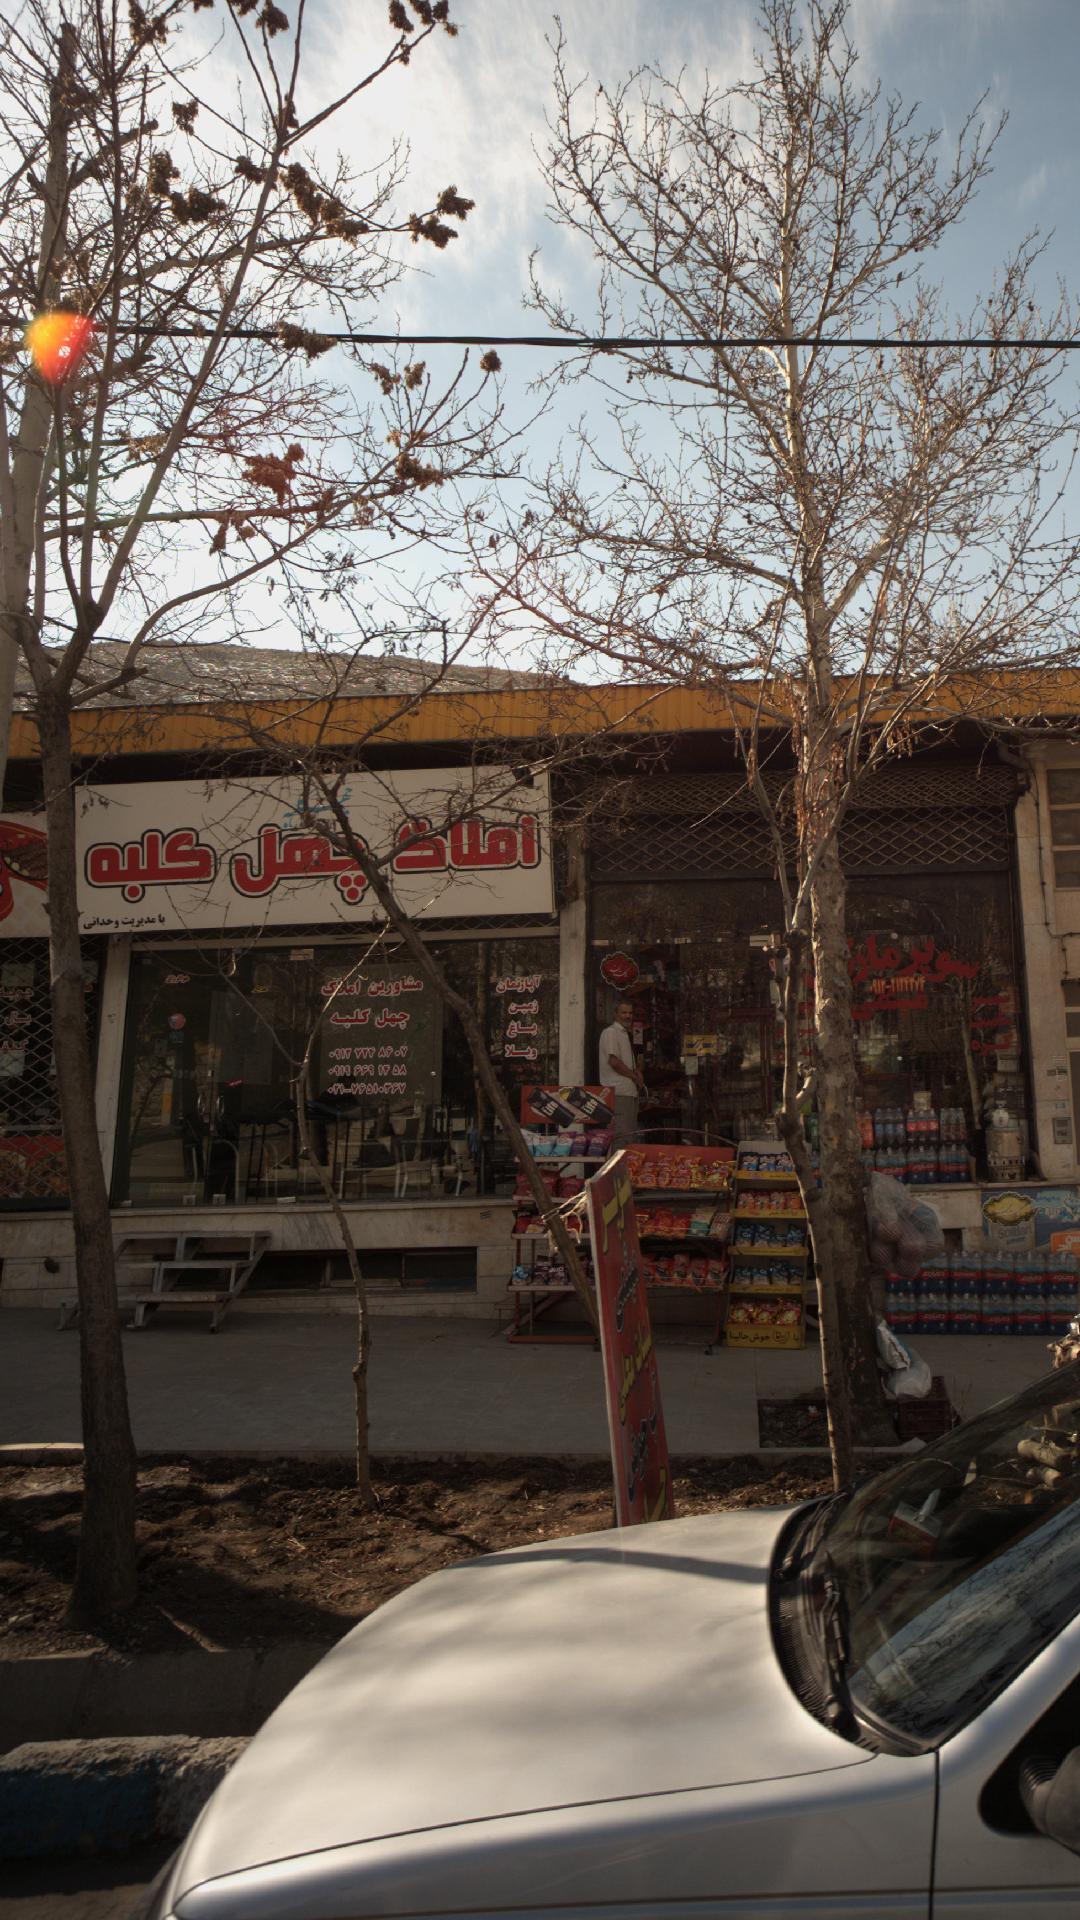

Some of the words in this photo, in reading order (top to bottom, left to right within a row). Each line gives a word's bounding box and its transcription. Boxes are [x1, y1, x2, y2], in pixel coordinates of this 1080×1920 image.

[390, 812, 541, 874] املاک
[84, 827, 216, 903] کلبه
[228, 823, 378, 906] چهل
[121, 915, 156, 928] مدیریت
[158, 913, 166, 926] با
[320, 978, 361, 996] املاک
[368, 976, 424, 997] مشاورین
[496, 974, 541, 993] آپارتمان
[508, 999, 539, 1014] زمین
[330, 1008, 371, 1029] کلبه
[375, 1008, 410, 1030] چهل
[507, 1020, 538, 1038] باغ
[504, 1044, 538, 1060] ویلا
